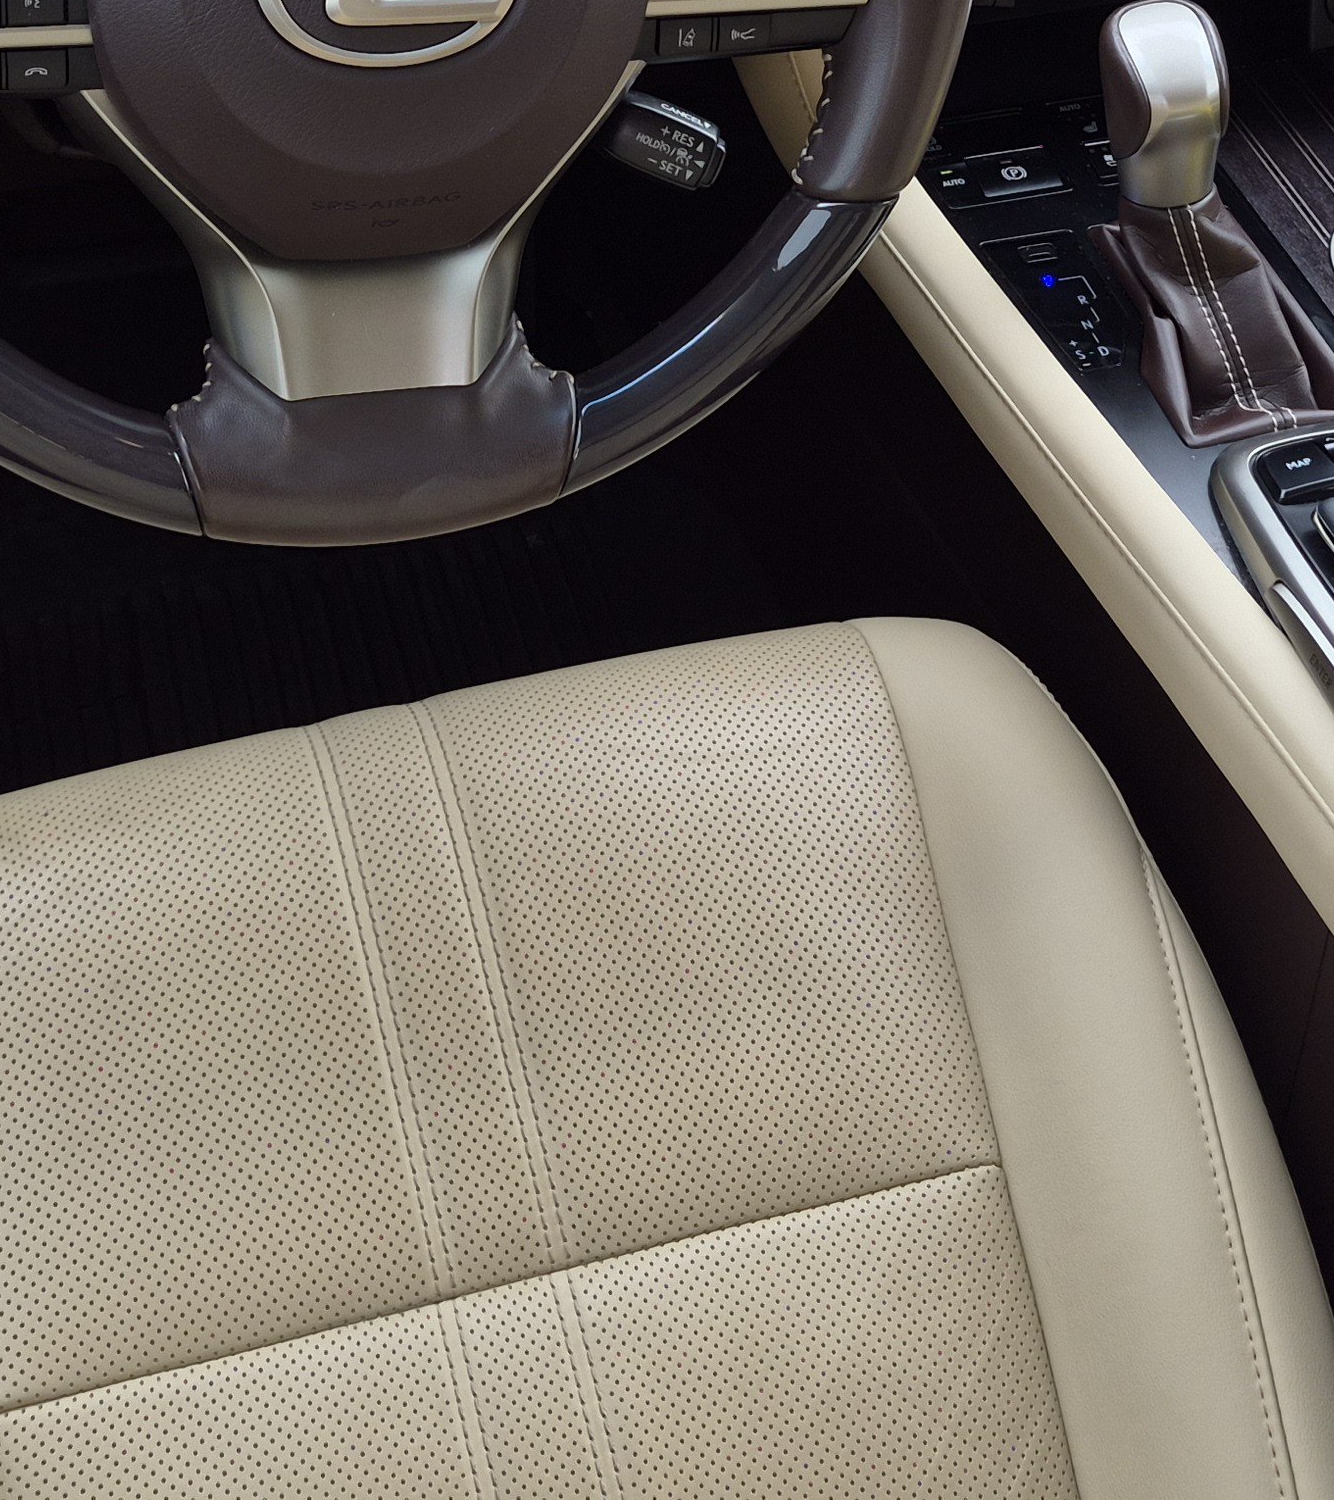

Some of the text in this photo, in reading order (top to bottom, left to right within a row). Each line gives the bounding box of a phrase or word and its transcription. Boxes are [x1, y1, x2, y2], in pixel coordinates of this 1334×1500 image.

[660, 103, 703, 126] CANCEL
[672, 130, 695, 148] RES
[659, 161, 683, 176] SET
[943, 178, 966, 187] AUTO
[1077, 295, 1090, 305] R
[1080, 320, 1094, 330] N
[1097, 345, 1110, 357] D
[1285, 457, 1312, 471] MAP
